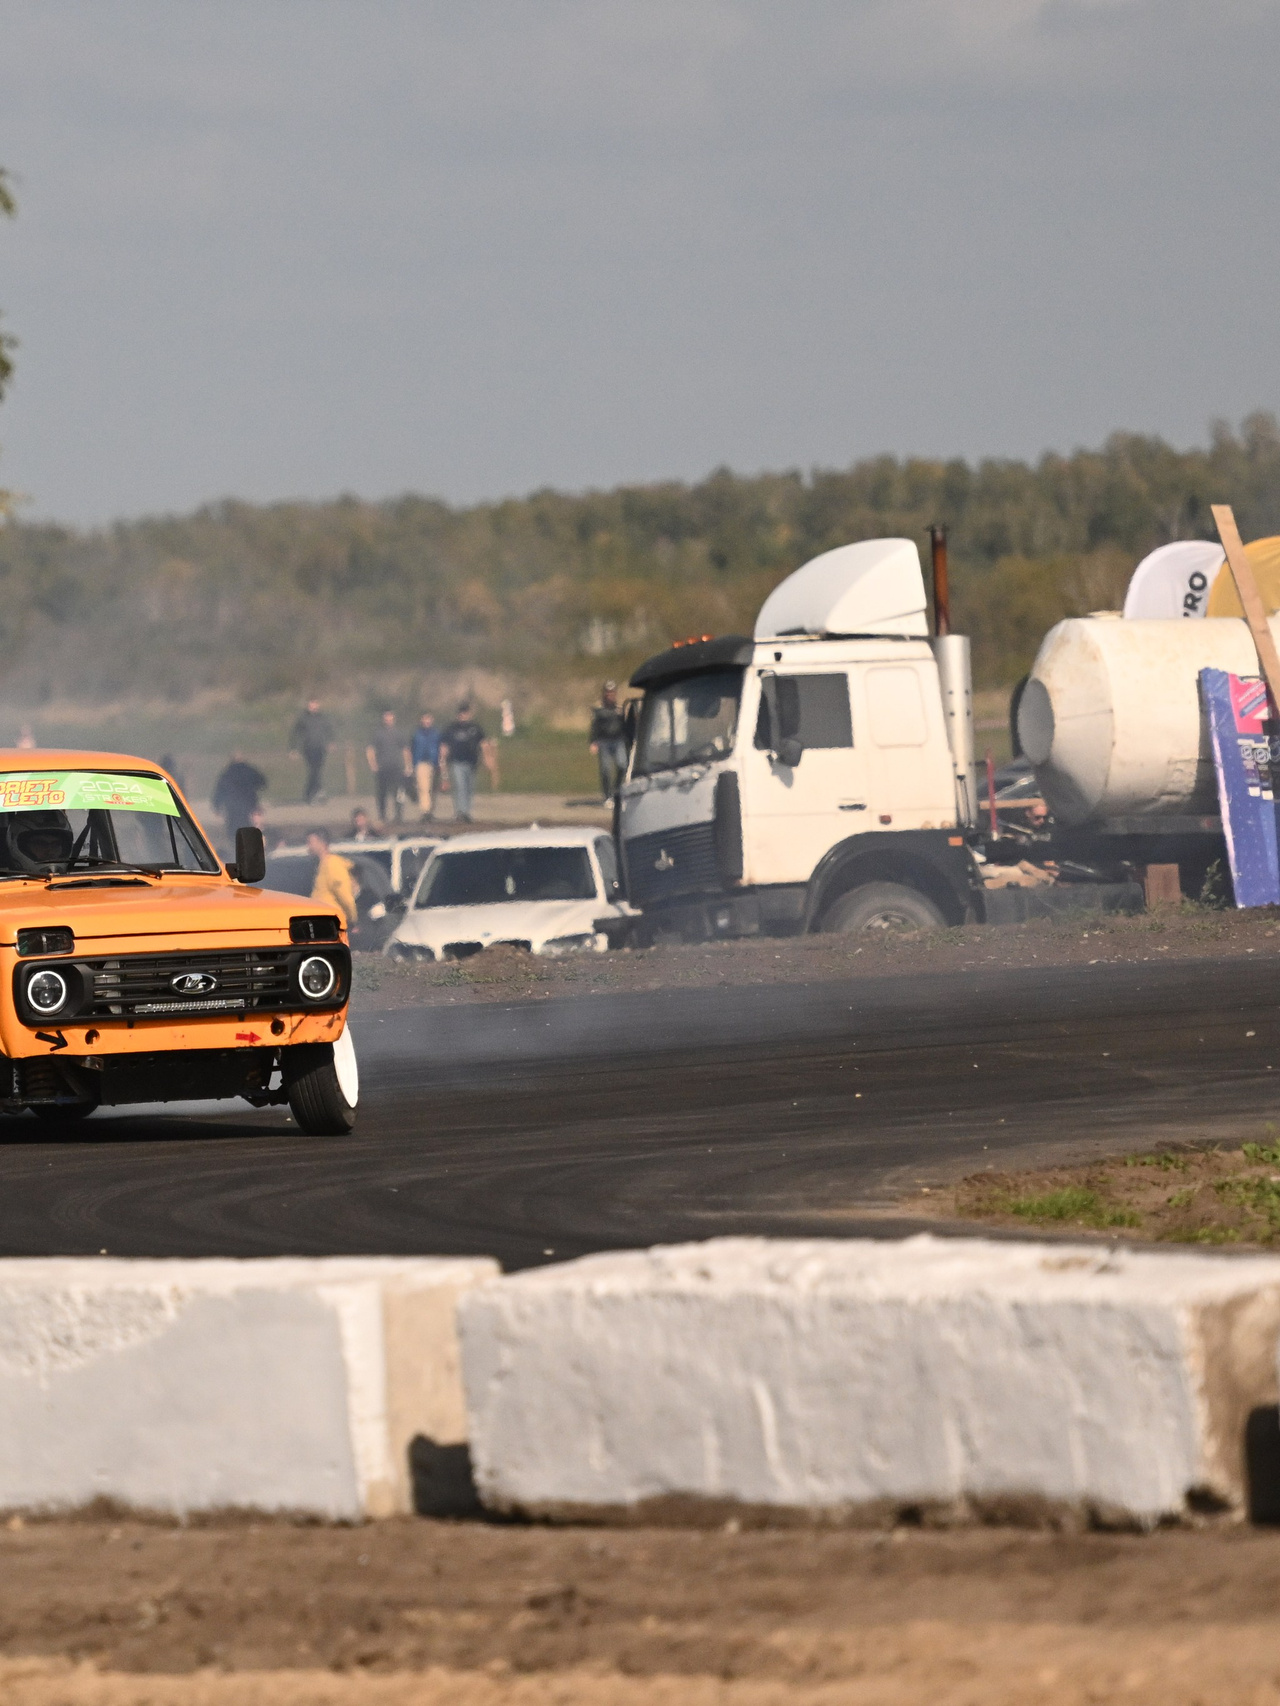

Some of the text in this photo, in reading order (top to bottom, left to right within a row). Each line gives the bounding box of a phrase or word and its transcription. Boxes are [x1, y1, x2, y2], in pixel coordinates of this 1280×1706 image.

[1182, 570, 1208, 618] RO
[79, 780, 142, 795] 2024
[3, 790, 65, 807] LETO
